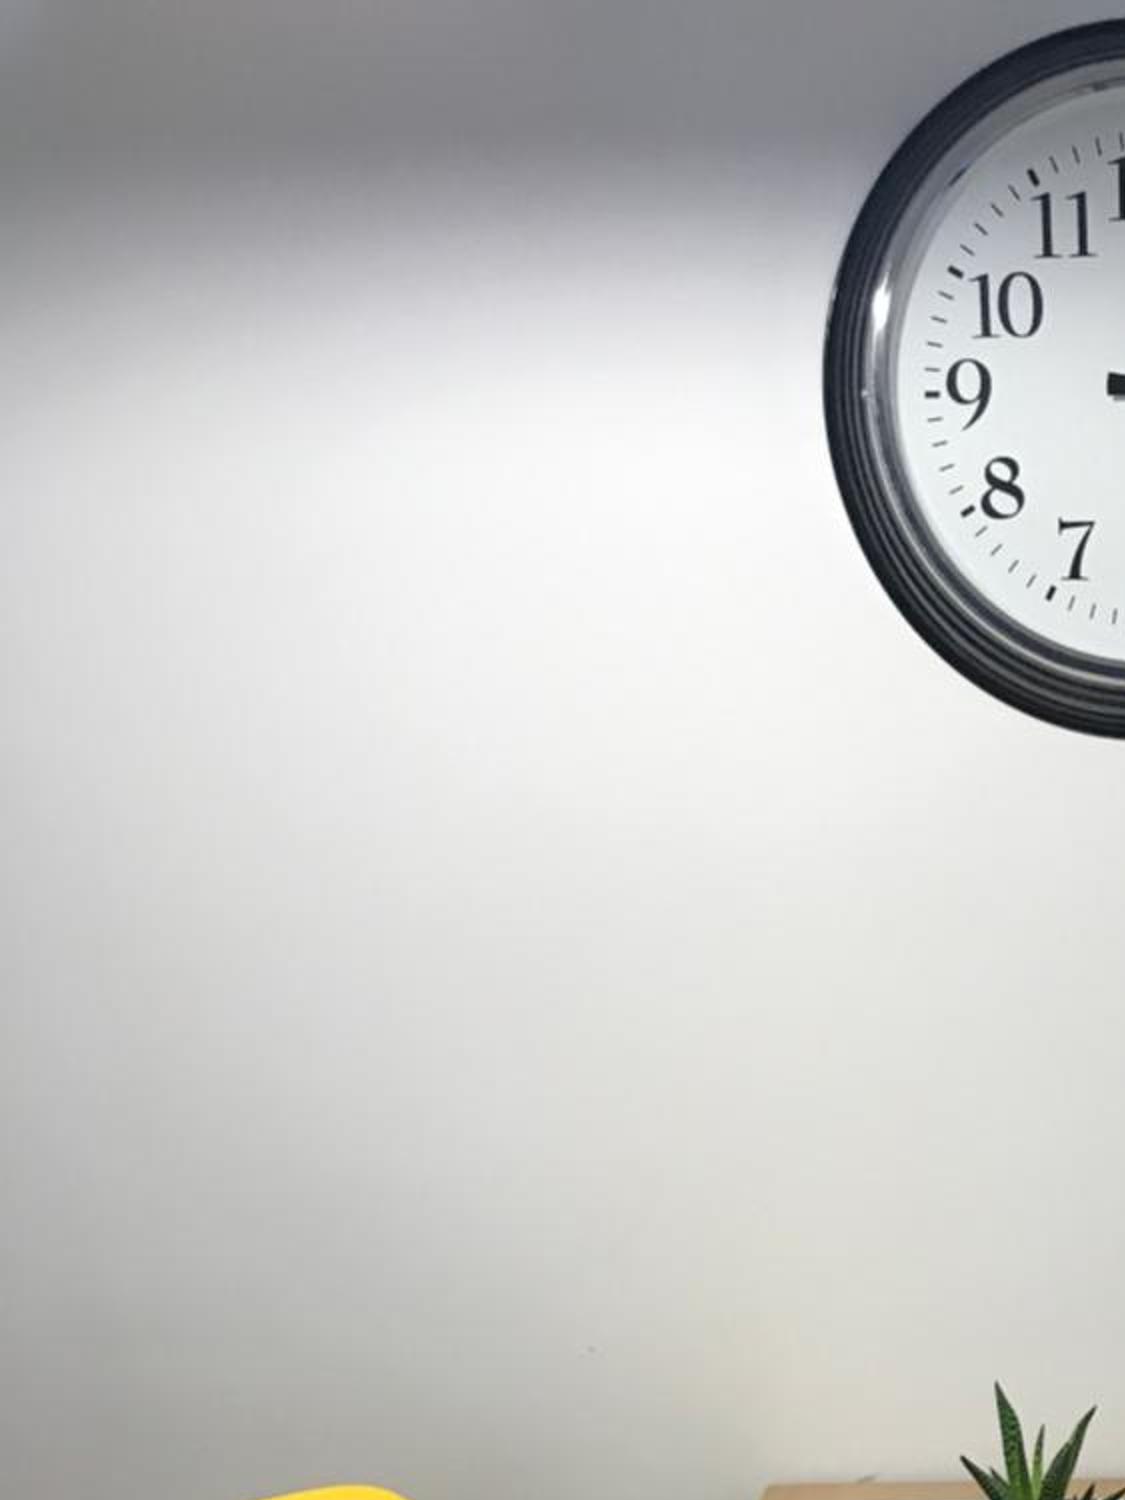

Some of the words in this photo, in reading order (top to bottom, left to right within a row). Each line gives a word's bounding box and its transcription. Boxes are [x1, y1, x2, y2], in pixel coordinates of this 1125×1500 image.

[1032, 191, 1097, 258] 11
[971, 272, 1043, 337] 10
[946, 359, 991, 429] 9
[981, 457, 1024, 519] 8
[1059, 519, 1095, 580] 7
